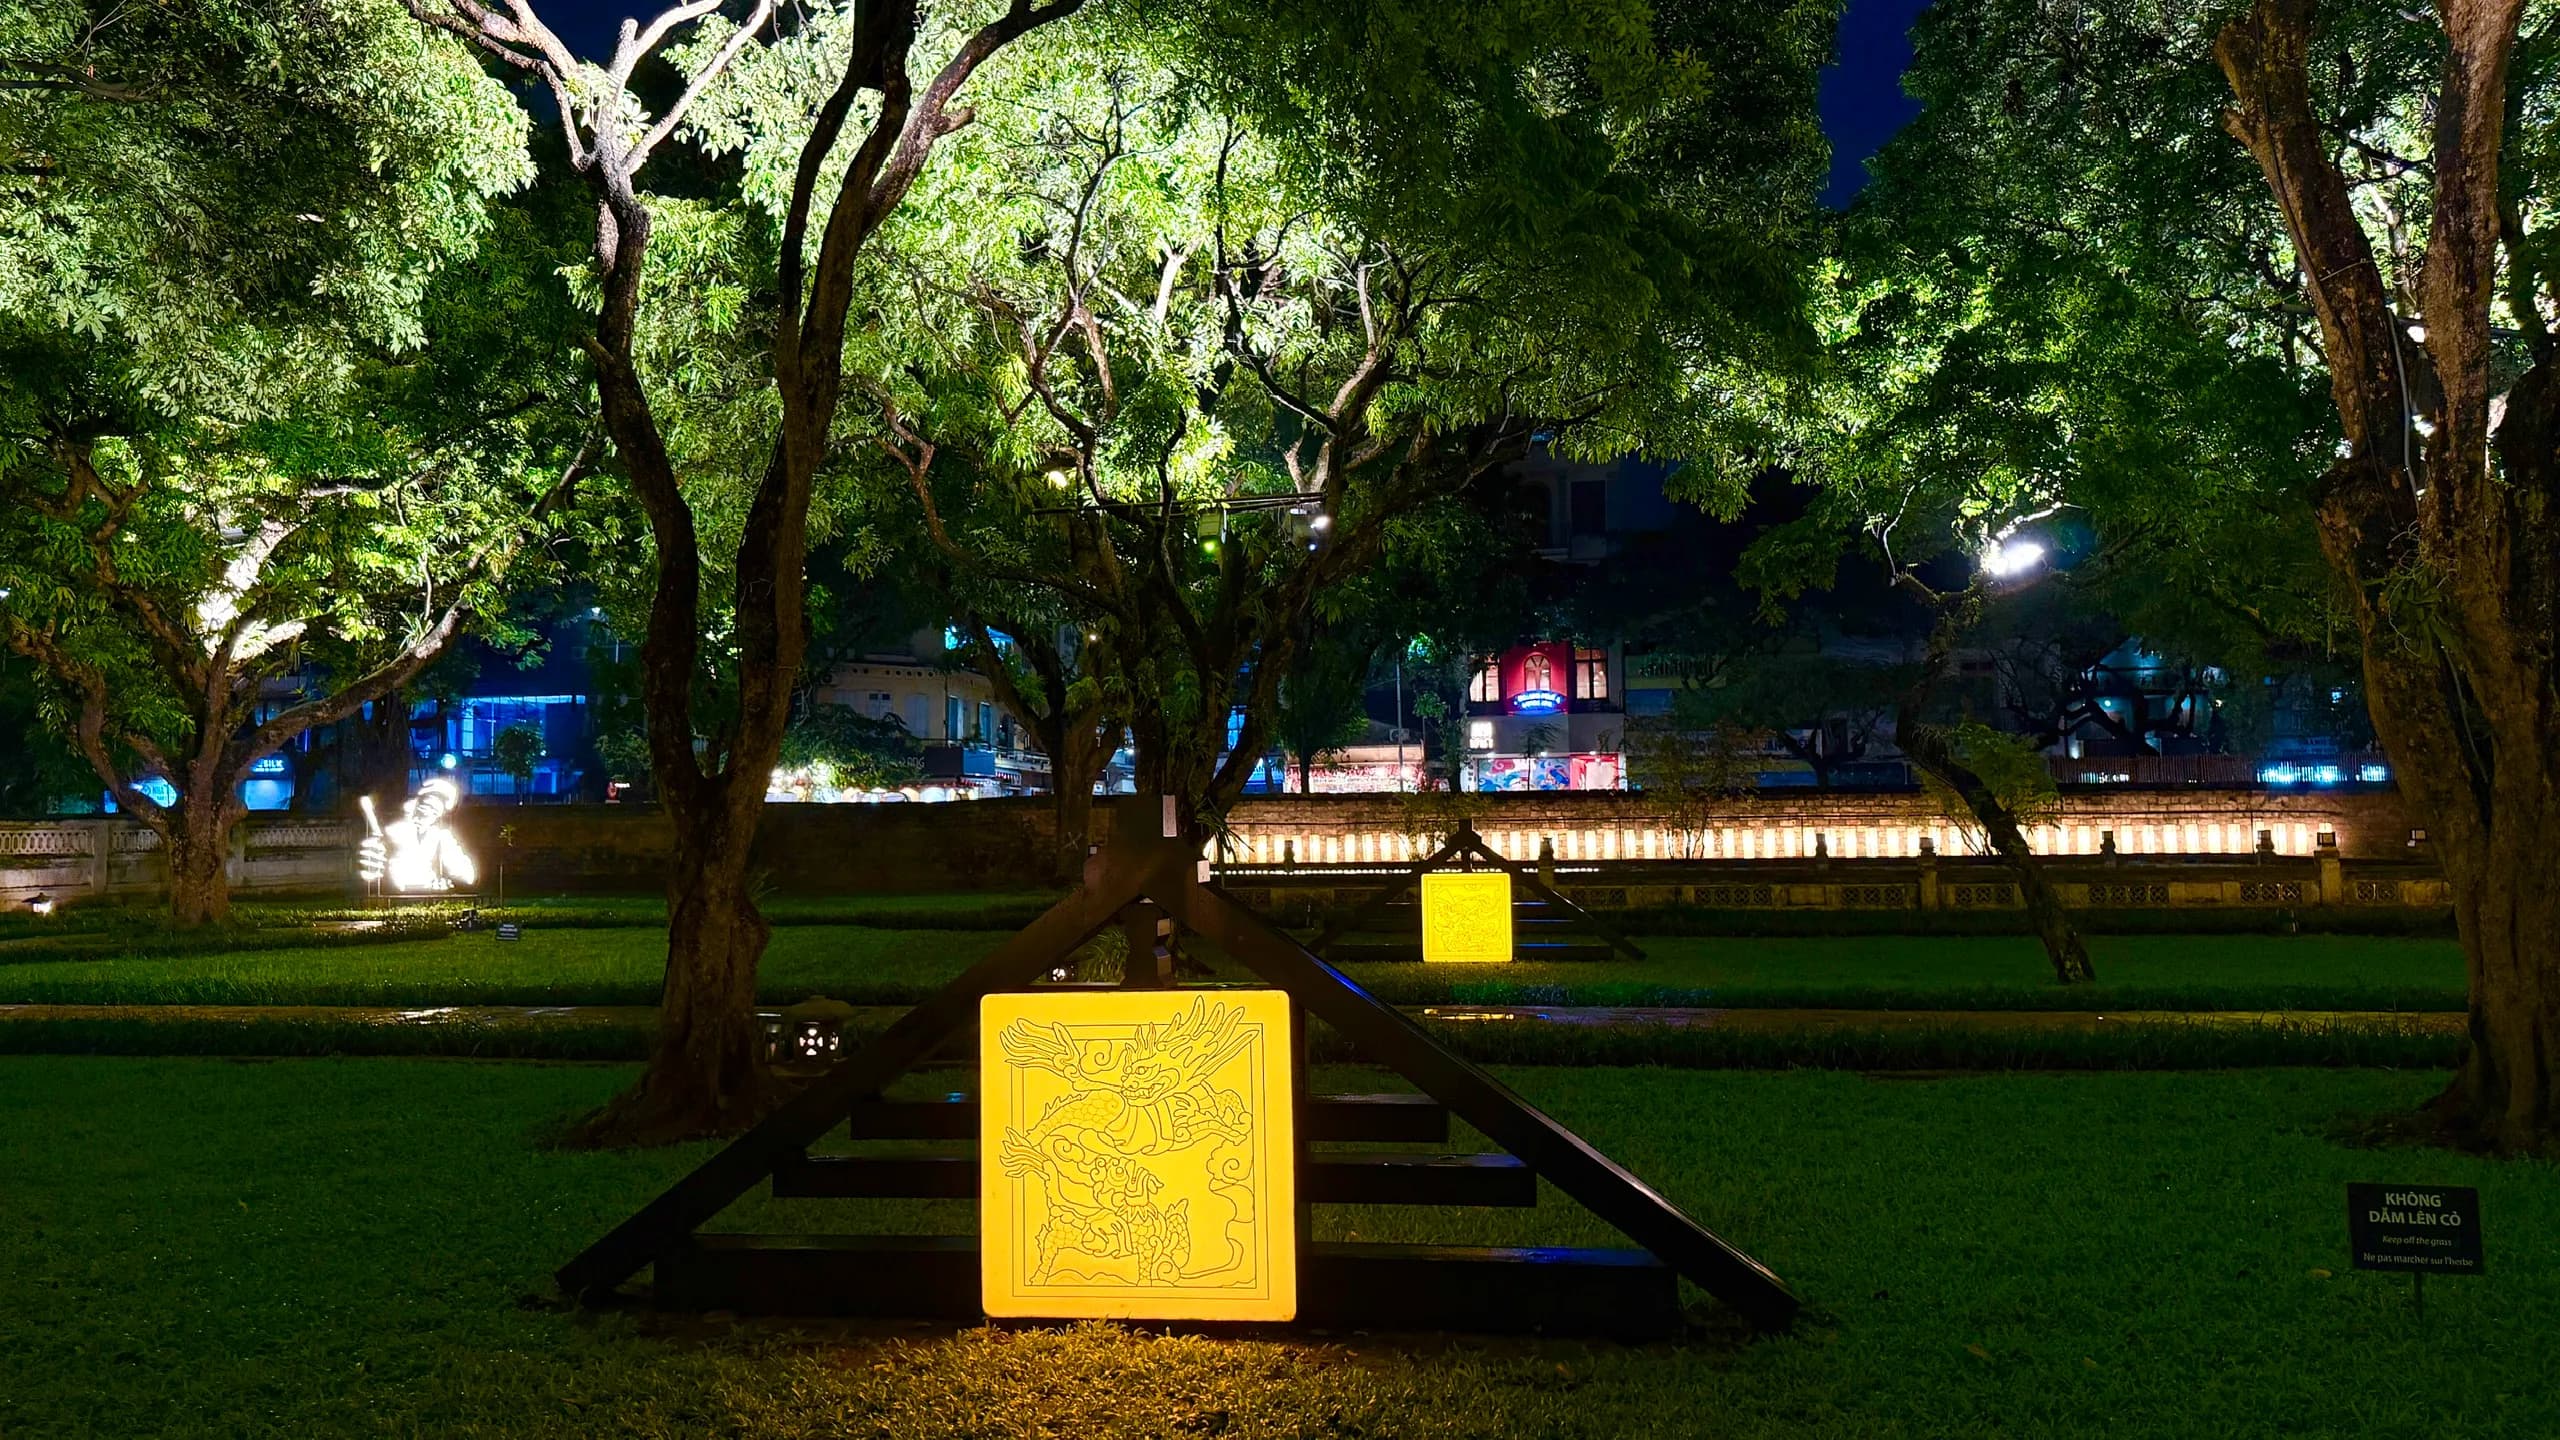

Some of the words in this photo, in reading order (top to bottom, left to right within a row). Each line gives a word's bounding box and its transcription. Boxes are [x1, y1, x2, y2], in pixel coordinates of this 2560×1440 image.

[2385, 1191, 2442, 1208] KHÔNG
[2408, 1209, 2437, 1225] LÊN
[2440, 1210, 2462, 1226] CỎ
[2382, 1235, 2402, 1246] Keep
[2403, 1235, 2415, 1245] off
[2416, 1236, 2429, 1245] the
[2430, 1238, 2452, 1247] grass
[2363, 1252, 2376, 1261] Ne
[2377, 1254, 2392, 1263] pas
[2393, 1254, 2428, 1264] marcher
[2430, 1257, 2443, 1265] sur
[2444, 1256, 2474, 1267] l'herbe
